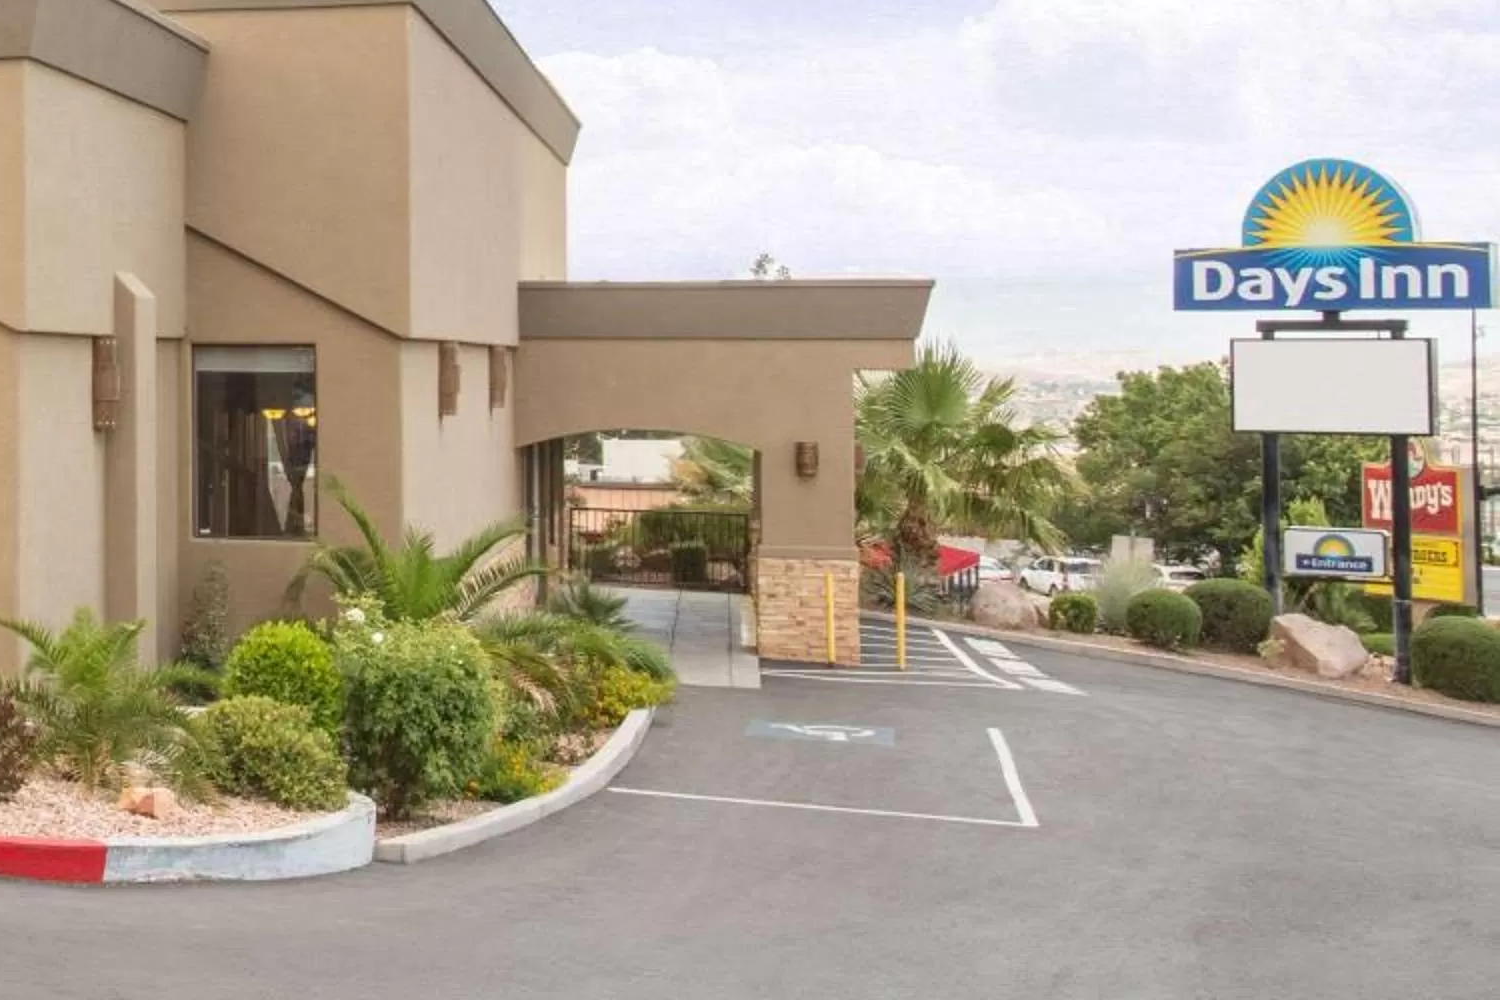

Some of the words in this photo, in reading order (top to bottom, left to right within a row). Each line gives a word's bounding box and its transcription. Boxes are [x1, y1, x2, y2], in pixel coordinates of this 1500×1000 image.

[1192, 260, 1347, 307] Days
[1359, 257, 1470, 299] Inn
[1311, 557, 1368, 570] Entrance
